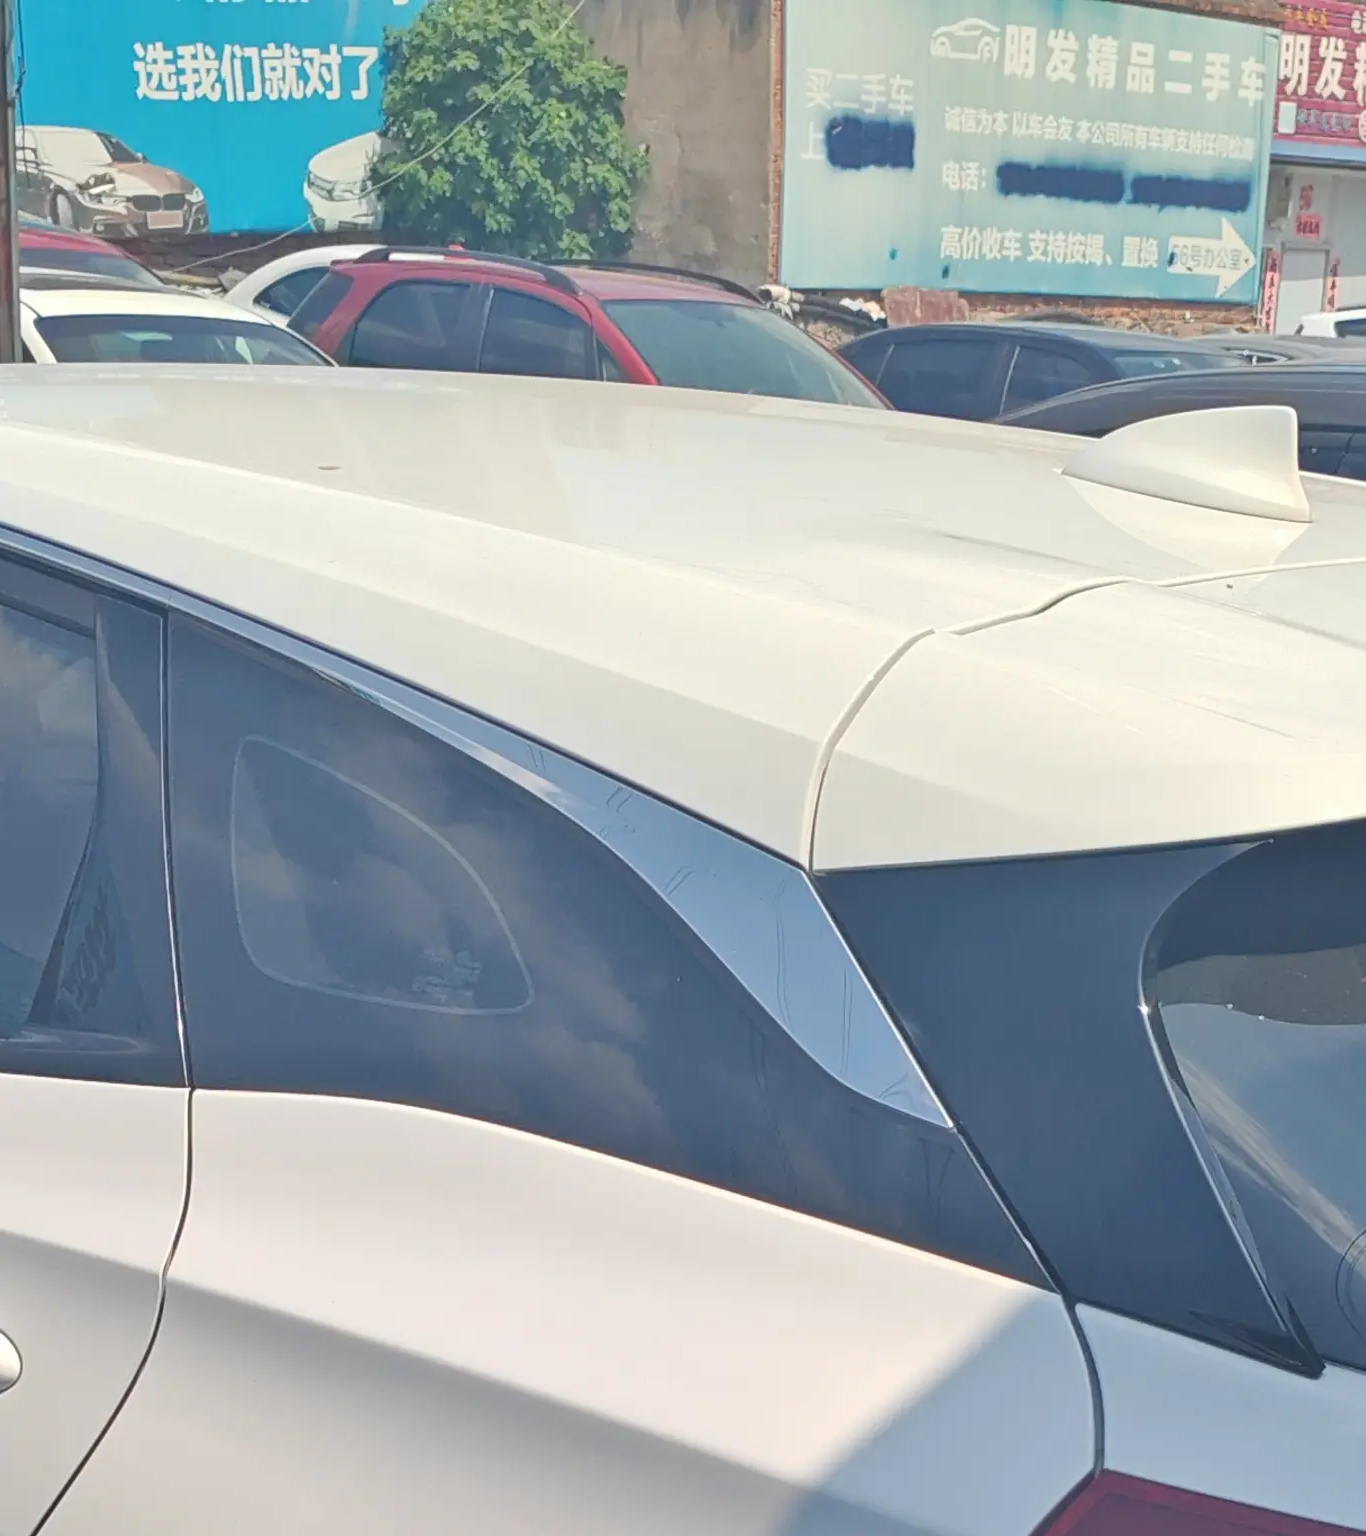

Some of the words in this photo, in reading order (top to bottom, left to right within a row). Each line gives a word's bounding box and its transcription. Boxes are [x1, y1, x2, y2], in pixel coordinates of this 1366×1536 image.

[133, 42, 378, 102] 选我们就对了
[1005, 24, 1266, 107] 明发精品二手车
[805, 68, 914, 116] 买二手车
[944, 106, 1008, 135] 诚信为本
[1012, 111, 1074, 142] 以车会友
[940, 225, 1022, 261] 高价收车
